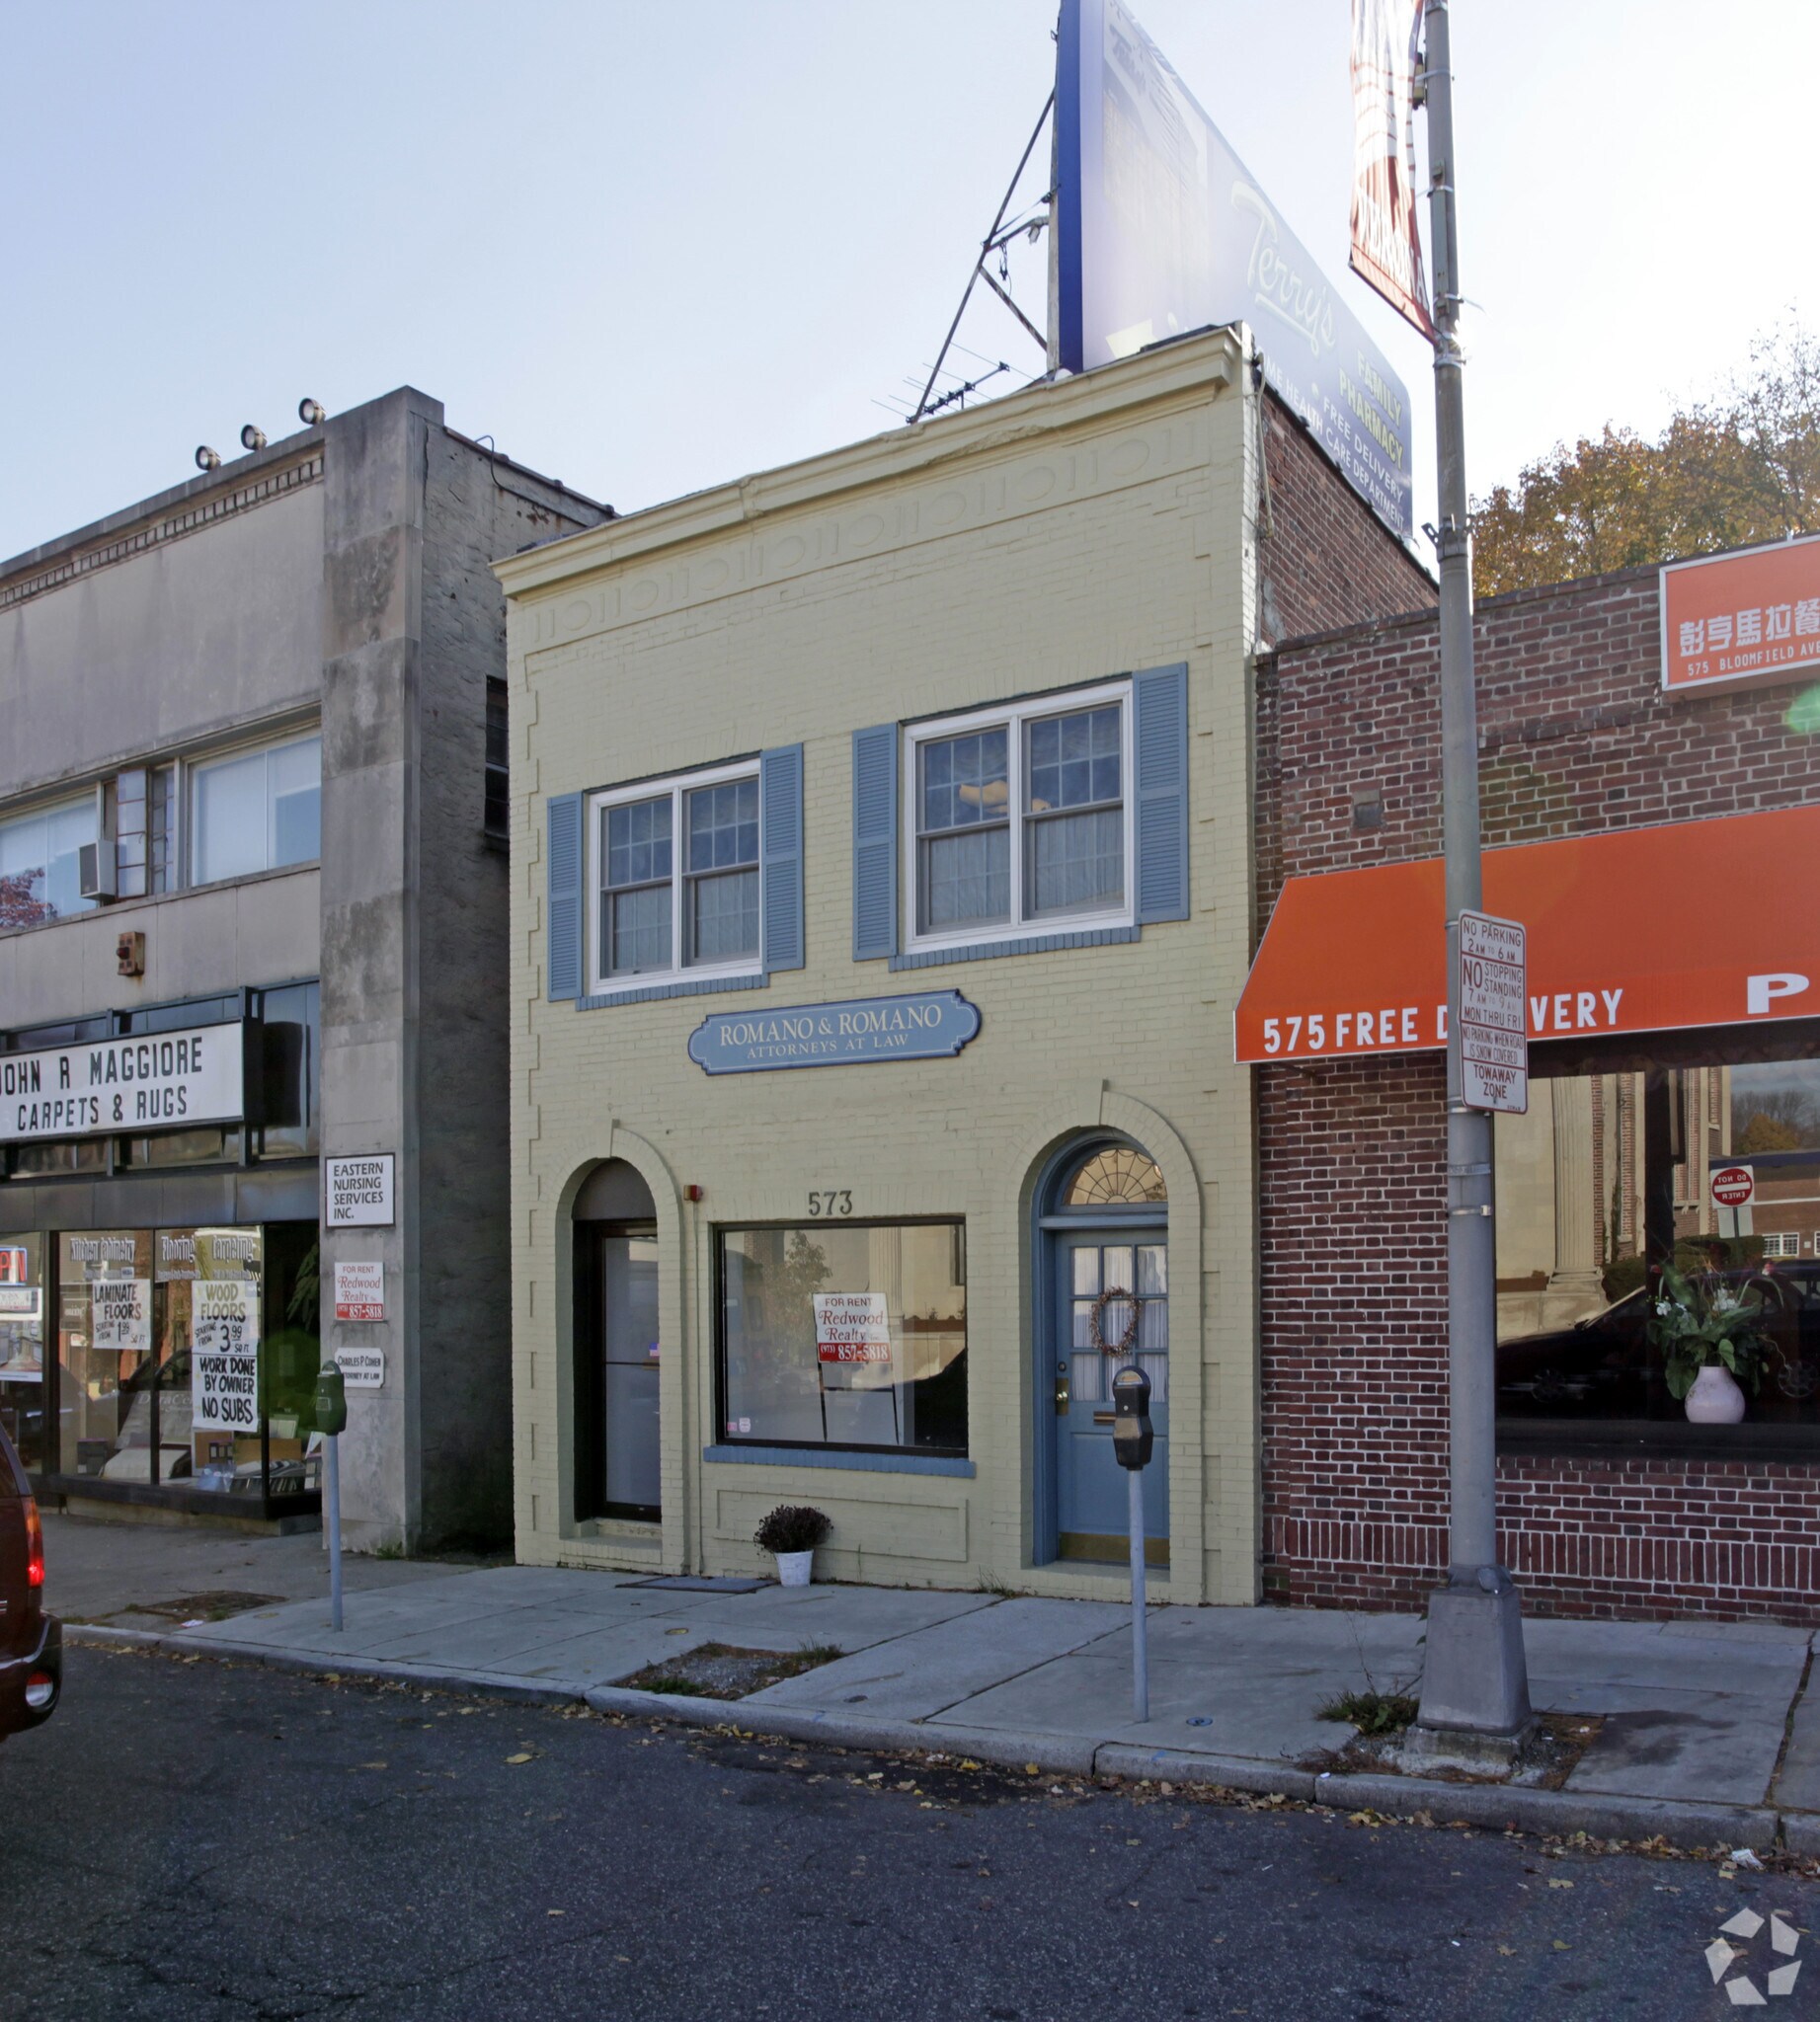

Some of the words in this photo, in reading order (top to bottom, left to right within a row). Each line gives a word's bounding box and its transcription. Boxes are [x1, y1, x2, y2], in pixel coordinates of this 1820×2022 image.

[1231, 180, 1336, 355] Terry's
[1358, 350, 1401, 430] FAMILY
[1339, 368, 1403, 470] PHARMACY
[1286, 378, 1323, 435] HEALTH
[1326, 427, 1351, 468] CARE
[1354, 459, 1404, 531] DEPARTMENT
[1323, 396, 1351, 440] FREE
[1355, 434, 1403, 503] DELIVERY
[1688, 661, 1709, 676] 575
[1720, 646, 1794, 670] BLOOMFIELD
[1464, 920, 1476, 936] NO
[1482, 924, 1521, 947] PARKING
[1498, 948, 1504, 960] 6
[1507, 951, 1516, 963] AM
[1463, 958, 1482, 988] NO
[1484, 962, 1522, 983] STOPPING
[1468, 987, 1474, 1002] 7
[1476, 993, 1486, 1005] AM
[1499, 995, 1505, 1009] 9
[1484, 977, 1522, 1000] STANDING
[720, 1016, 814, 1047] ROMANO
[819, 1019, 833, 1036] &
[839, 1004, 942, 1036] ROMANO
[1264, 1014, 1325, 1053] 575
[1336, 1007, 1418, 1048] FREE
[1437, 988, 1623, 1040] DVERY
[1464, 1005, 1481, 1022] MON
[1483, 1009, 1505, 1026] THRU
[1507, 1013, 1521, 1029] FRI
[747, 1040, 837, 1059] ATTORNEYS
[845, 1037, 867, 1051] AT
[873, 1034, 909, 1049] LAW
[1463, 1027, 1470, 1041] NO
[1471, 1028, 1493, 1045] PARKING
[1494, 1032, 1509, 1048] WHEN
[1510, 1035, 1524, 1050] ROAD
[1469, 1043, 1475, 1057] IS
[1476, 1045, 1492, 1060] SNOW
[1493, 1048, 1518, 1065] COVERED
[0, 1059, 40, 1097] OHN
[59, 1056, 70, 1089] R
[90, 1037, 202, 1086] MAGGIORE
[1473, 1063, 1517, 1085] TOWAWAY
[1483, 1081, 1508, 1100] ZONE
[18, 1096, 99, 1131] CARPETS
[113, 1093, 123, 1123] &
[136, 1085, 188, 1121] RUGS
[334, 1162, 384, 1177] EASTERN
[334, 1177, 381, 1192] NURSING
[334, 1191, 384, 1205] SERVICES
[808, 1190, 853, 1216] 573
[334, 1206, 355, 1220] INC.
[205, 1283, 239, 1302] WOOD
[337, 1275, 381, 1289] Redwood
[94, 1283, 138, 1304] LAMINATE
[341, 1289, 369, 1302] Realty
[825, 1297, 845, 1307] FOR
[847, 1297, 873, 1307] RENT
[104, 1302, 142, 1321] FLOORS
[200, 1301, 247, 1323] FLOORS
[349, 1304, 382, 1318] 857-5818
[819, 1310, 884, 1325] Redwood
[95, 1320, 116, 1334] STARTING
[194, 1321, 217, 1339] STARTING
[825, 1327, 866, 1342] Realty
[198, 1333, 212, 1348] FROM
[234, 1343, 243, 1354] SQ
[820, 1344, 835, 1354] (973)
[837, 1344, 889, 1361] 857-5818
[199, 1357, 228, 1374] WORK
[229, 1357, 256, 1376] DONE
[338, 1355, 360, 1367] CHARLES
[204, 1373, 217, 1392] BY
[218, 1374, 255, 1395] OWNER
[363, 1372, 369, 1381] AT
[369, 1372, 380, 1381] LAW
[201, 1396, 219, 1420] NO
[220, 1396, 254, 1425] SUBS
